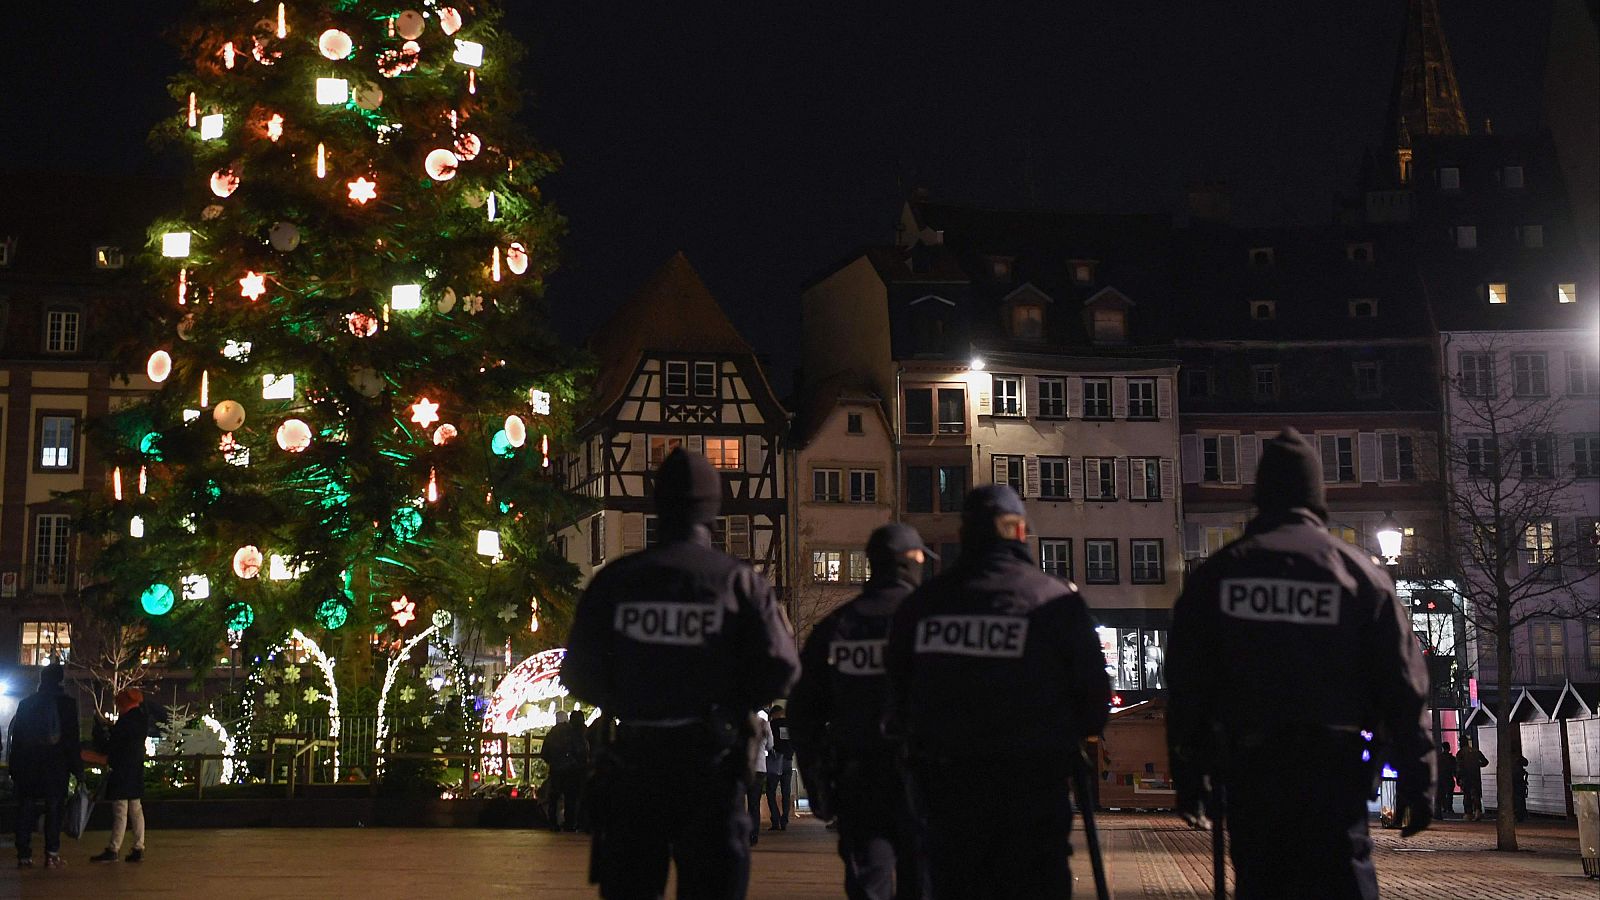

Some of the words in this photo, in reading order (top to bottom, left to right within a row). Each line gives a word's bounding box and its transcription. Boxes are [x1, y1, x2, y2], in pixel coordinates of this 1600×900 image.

[1229, 584, 1332, 617] POLICE
[622, 607, 714, 637] POLICE
[924, 620, 1020, 650] POLICE
[836, 645, 883, 669] POL
